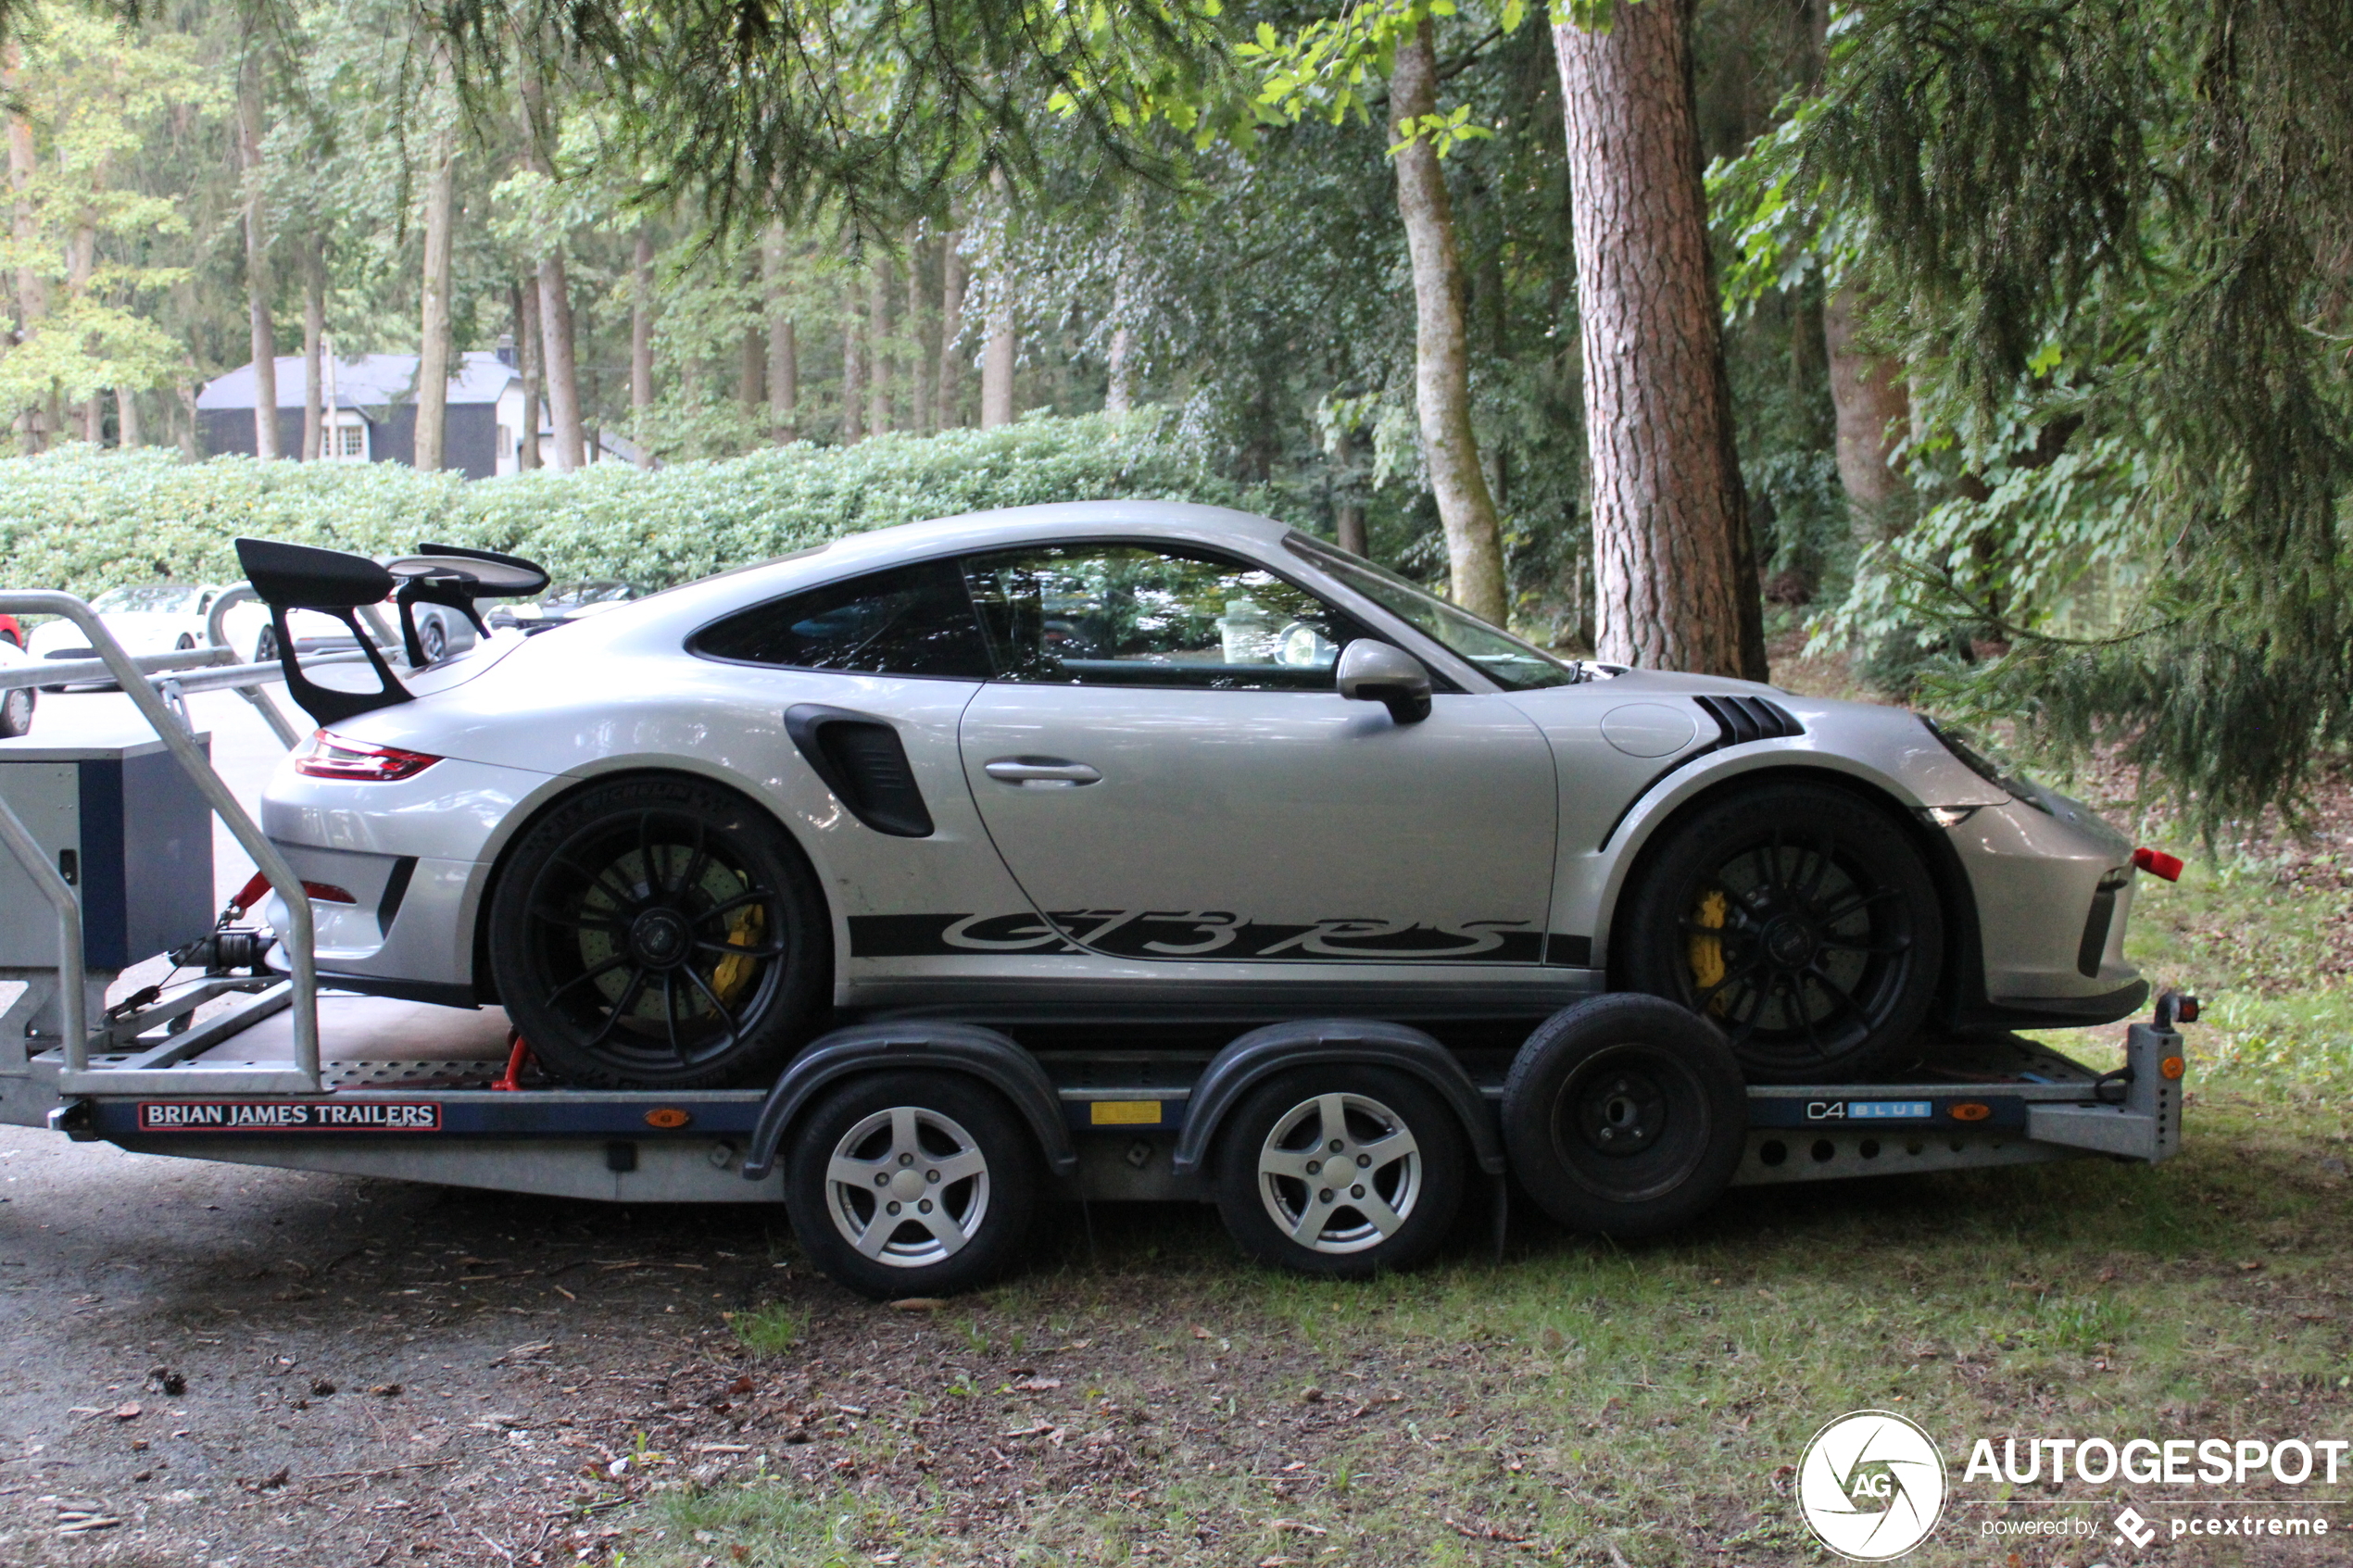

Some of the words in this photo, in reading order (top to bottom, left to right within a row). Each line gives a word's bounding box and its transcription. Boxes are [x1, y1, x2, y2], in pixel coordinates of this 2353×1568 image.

[941, 909, 1244, 955] GT3
[1255, 918, 1531, 957] RS
[148, 1105, 222, 1123] BRIAN
[227, 1105, 308, 1126] JAMES
[315, 1105, 434, 1123] TRAILERS
[1806, 1101, 1845, 1120] C4
[1855, 1104, 1925, 1116] BLUE
